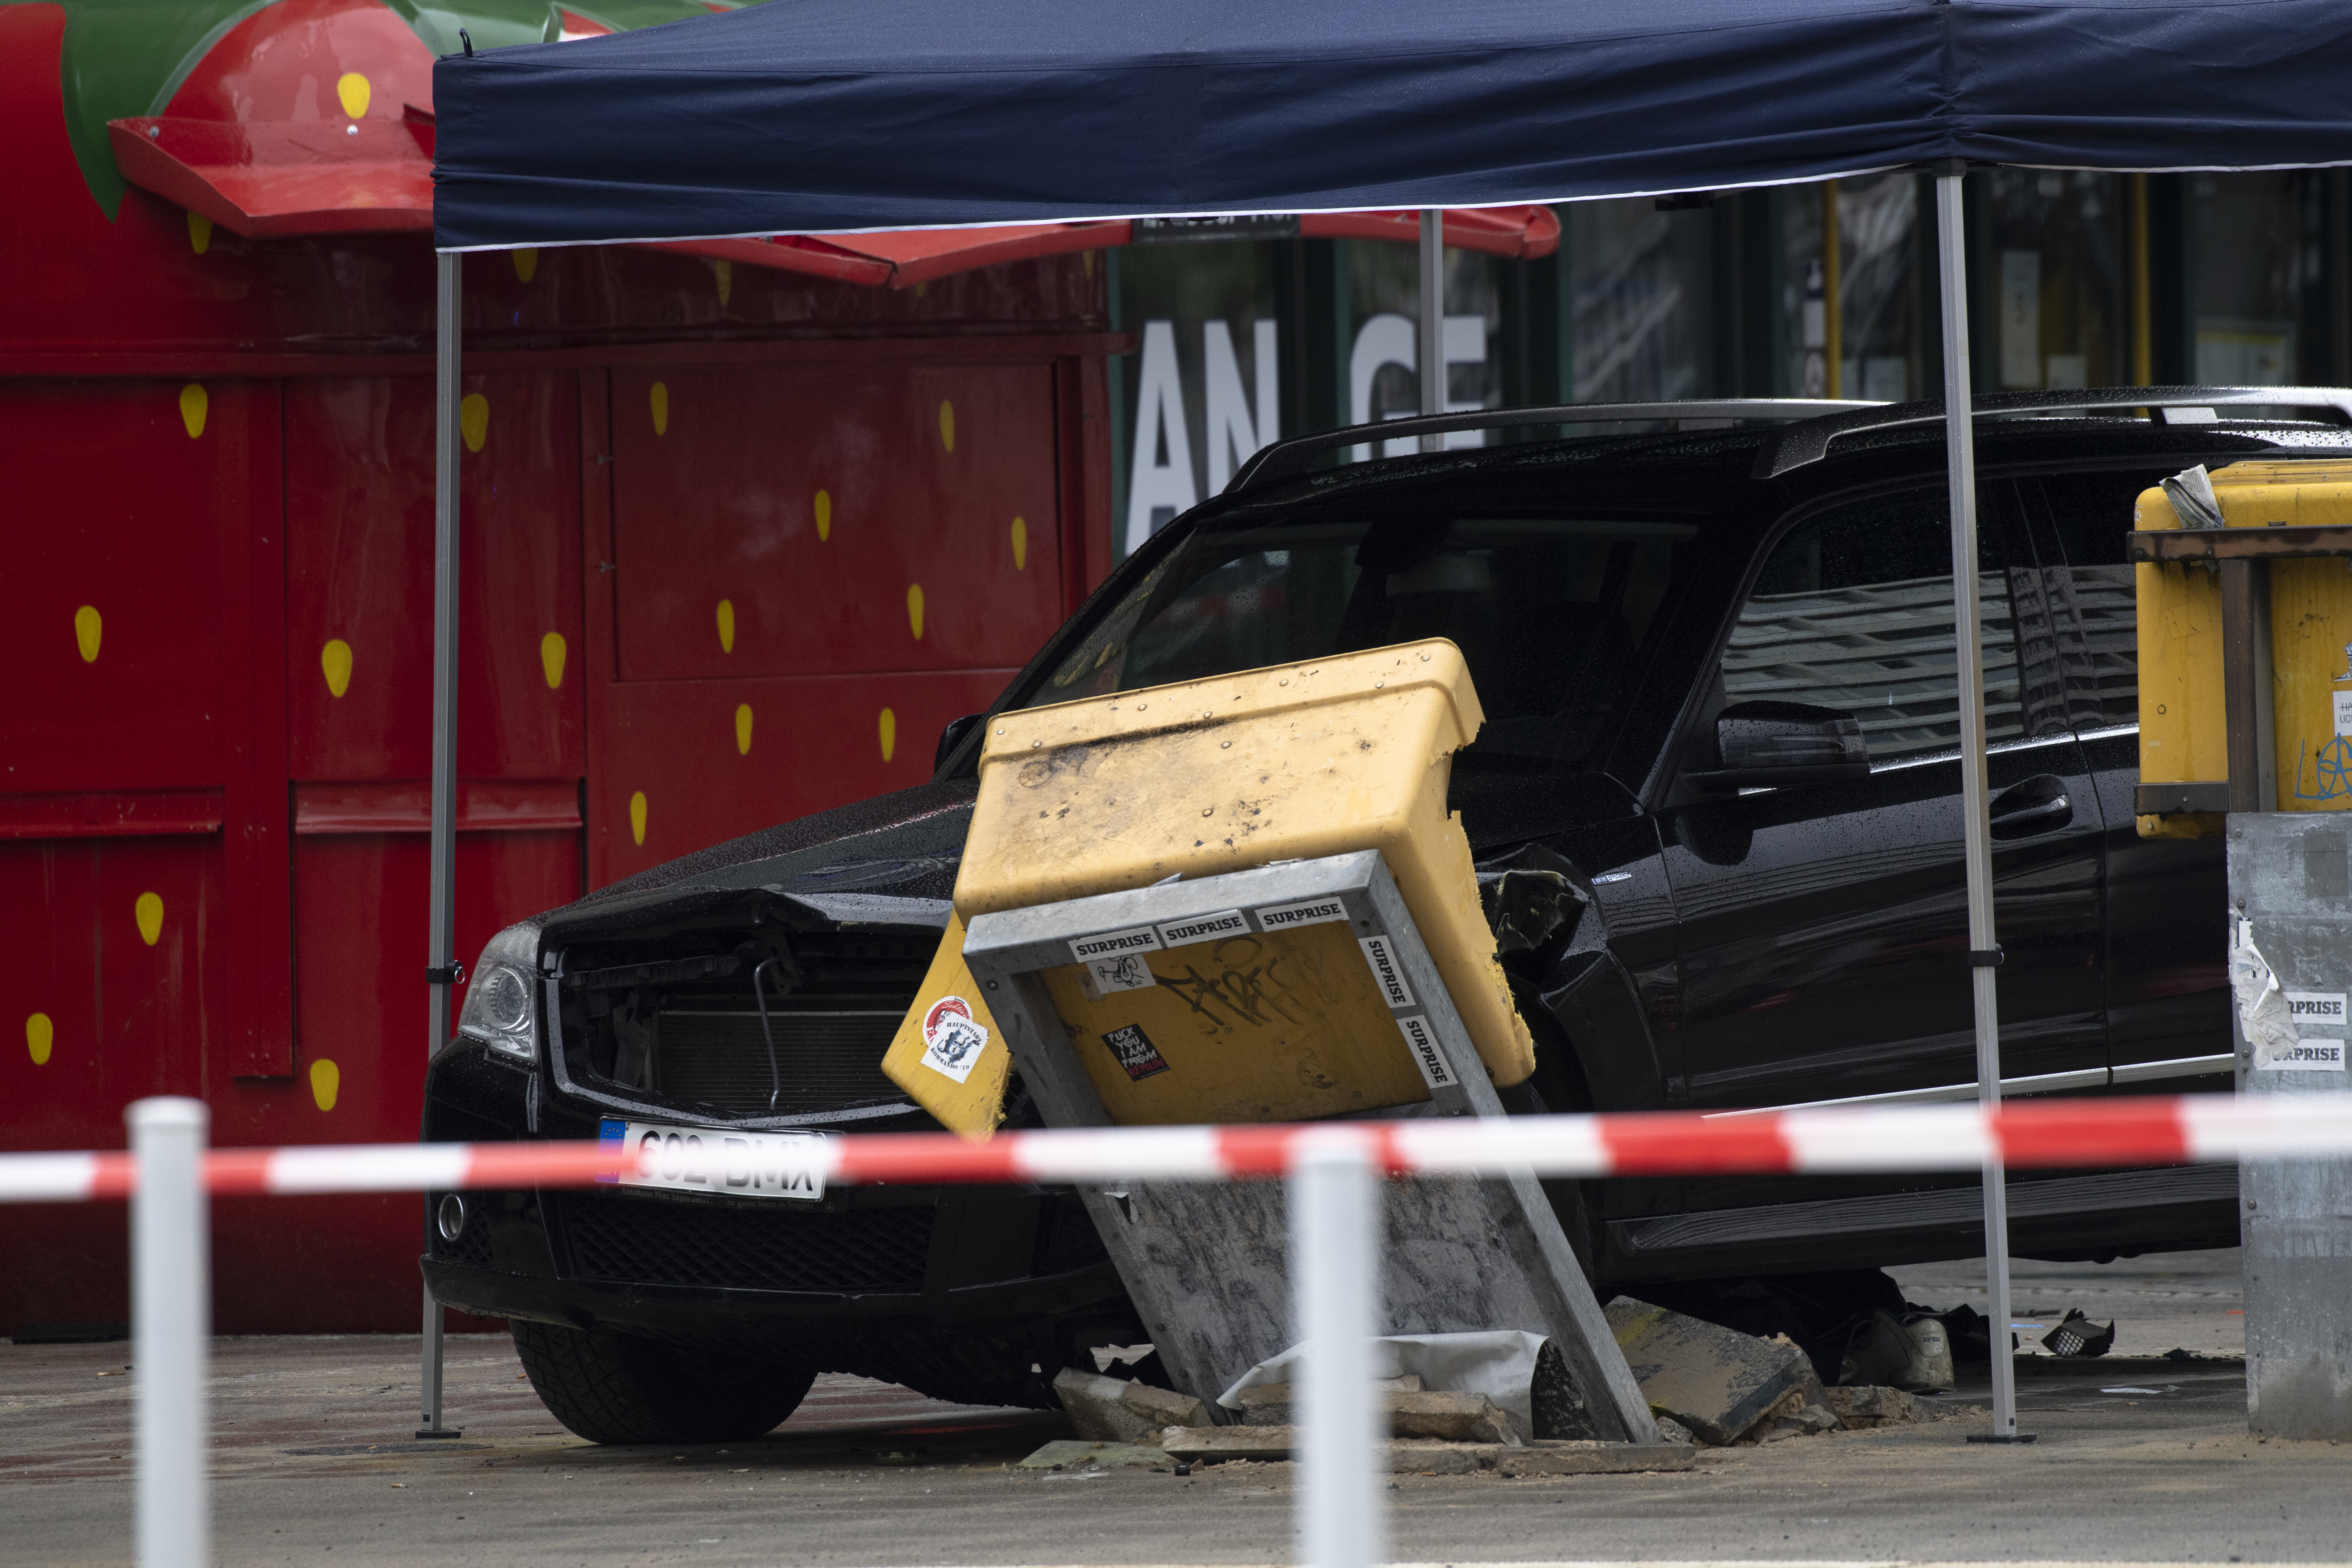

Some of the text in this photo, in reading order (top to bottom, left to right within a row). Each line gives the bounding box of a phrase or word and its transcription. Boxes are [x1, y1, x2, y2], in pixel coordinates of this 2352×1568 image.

[2340, 714, 2352, 724] UC
[1263, 904, 1341, 926] SURPRISE
[1166, 916, 1243, 940] SURPRISE
[1076, 933, 1154, 956] SURPRISE
[1368, 940, 1407, 1003] SURPRISE
[2287, 1001, 2342, 1015] RPRISE
[947, 1022, 983, 1042] HAUPTSTADT
[1108, 1026, 1136, 1043] FUCK
[1115, 1035, 1140, 1050] YOU
[1120, 1042, 1147, 1059] I AM
[1406, 1020, 1448, 1083] SURPRISE
[930, 1047, 958, 1070] KOMMANDO
[1122, 1049, 1157, 1069] FROM
[2273, 1048, 2340, 1062] RPRISE
[1127, 1057, 1165, 1077] BERLIN
[620, 1187, 653, 1198] Autohaus
[737, 1200, 757, 1209] guter
